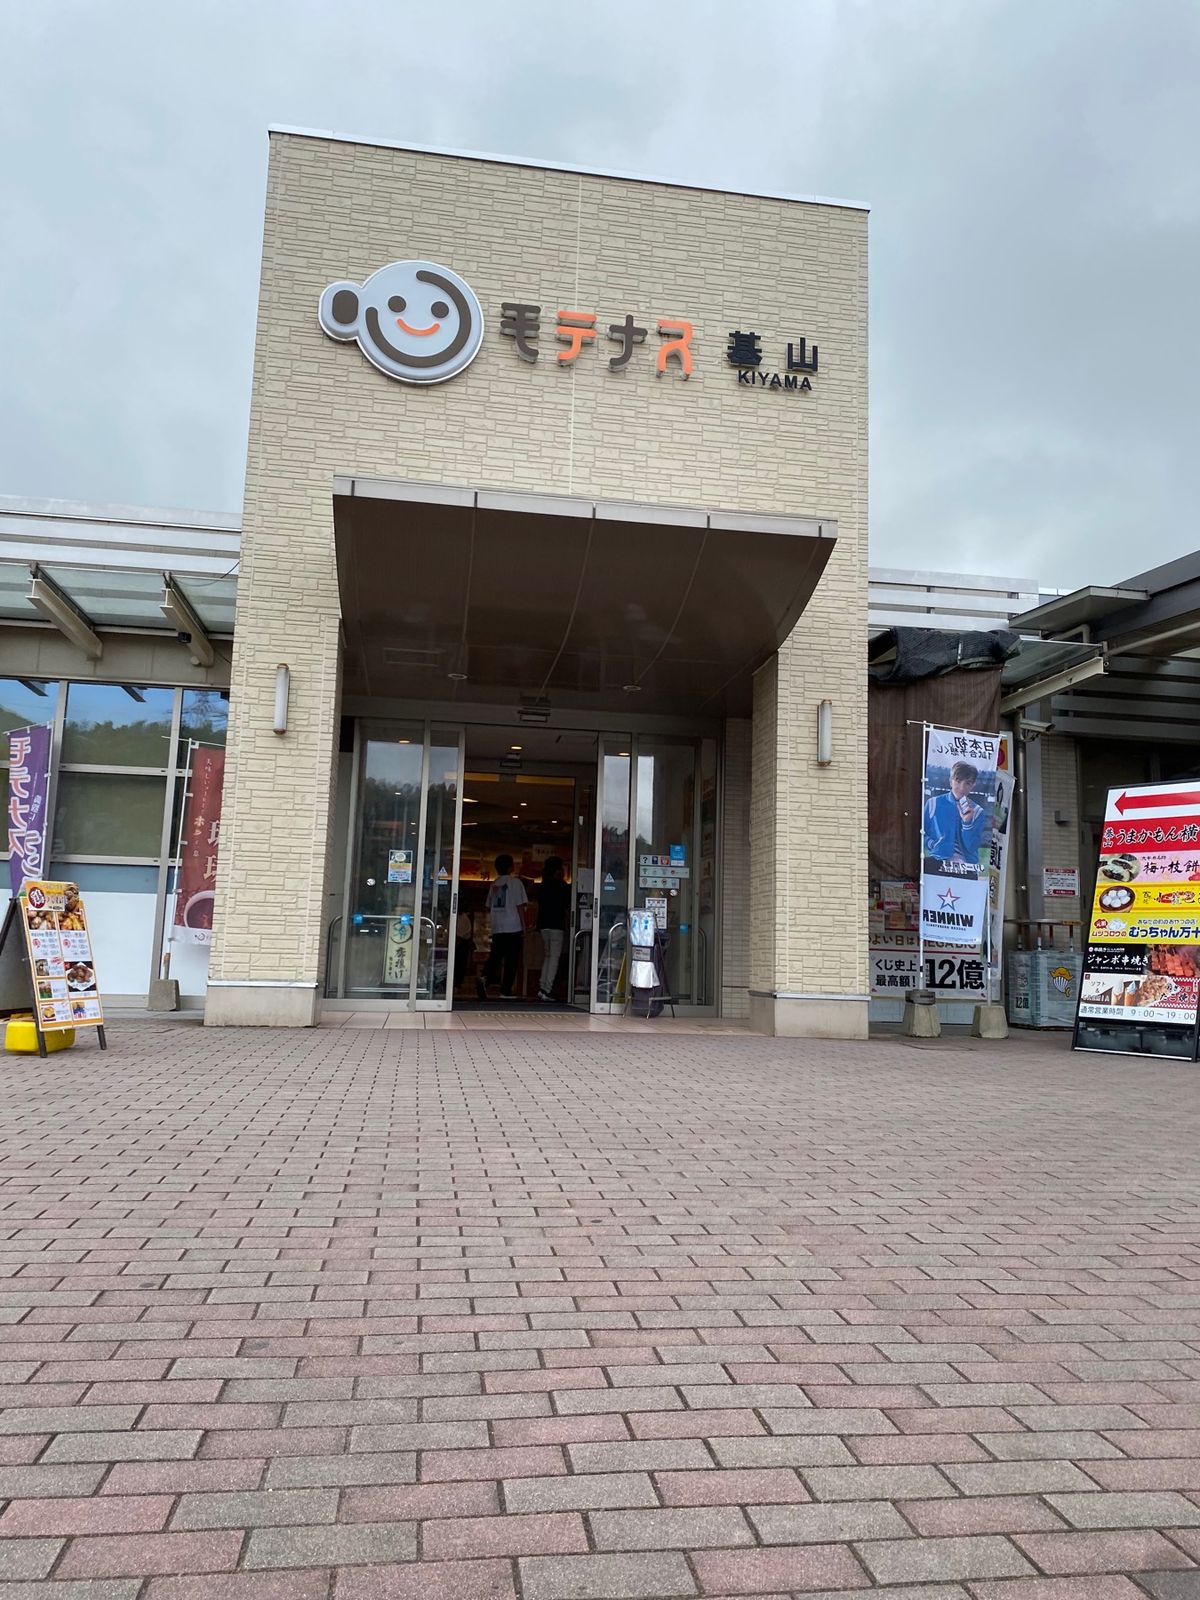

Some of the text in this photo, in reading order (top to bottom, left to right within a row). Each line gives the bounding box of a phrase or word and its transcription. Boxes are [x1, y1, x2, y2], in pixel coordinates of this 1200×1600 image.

[501, 302, 817, 380] モテナス 基山
[738, 370, 812, 391] KIYAMA
[875, 959, 917, 972] くじ史上
[1087, 954, 1150, 967] ジャンボ串焼き
[925, 959, 986, 989] 12億
